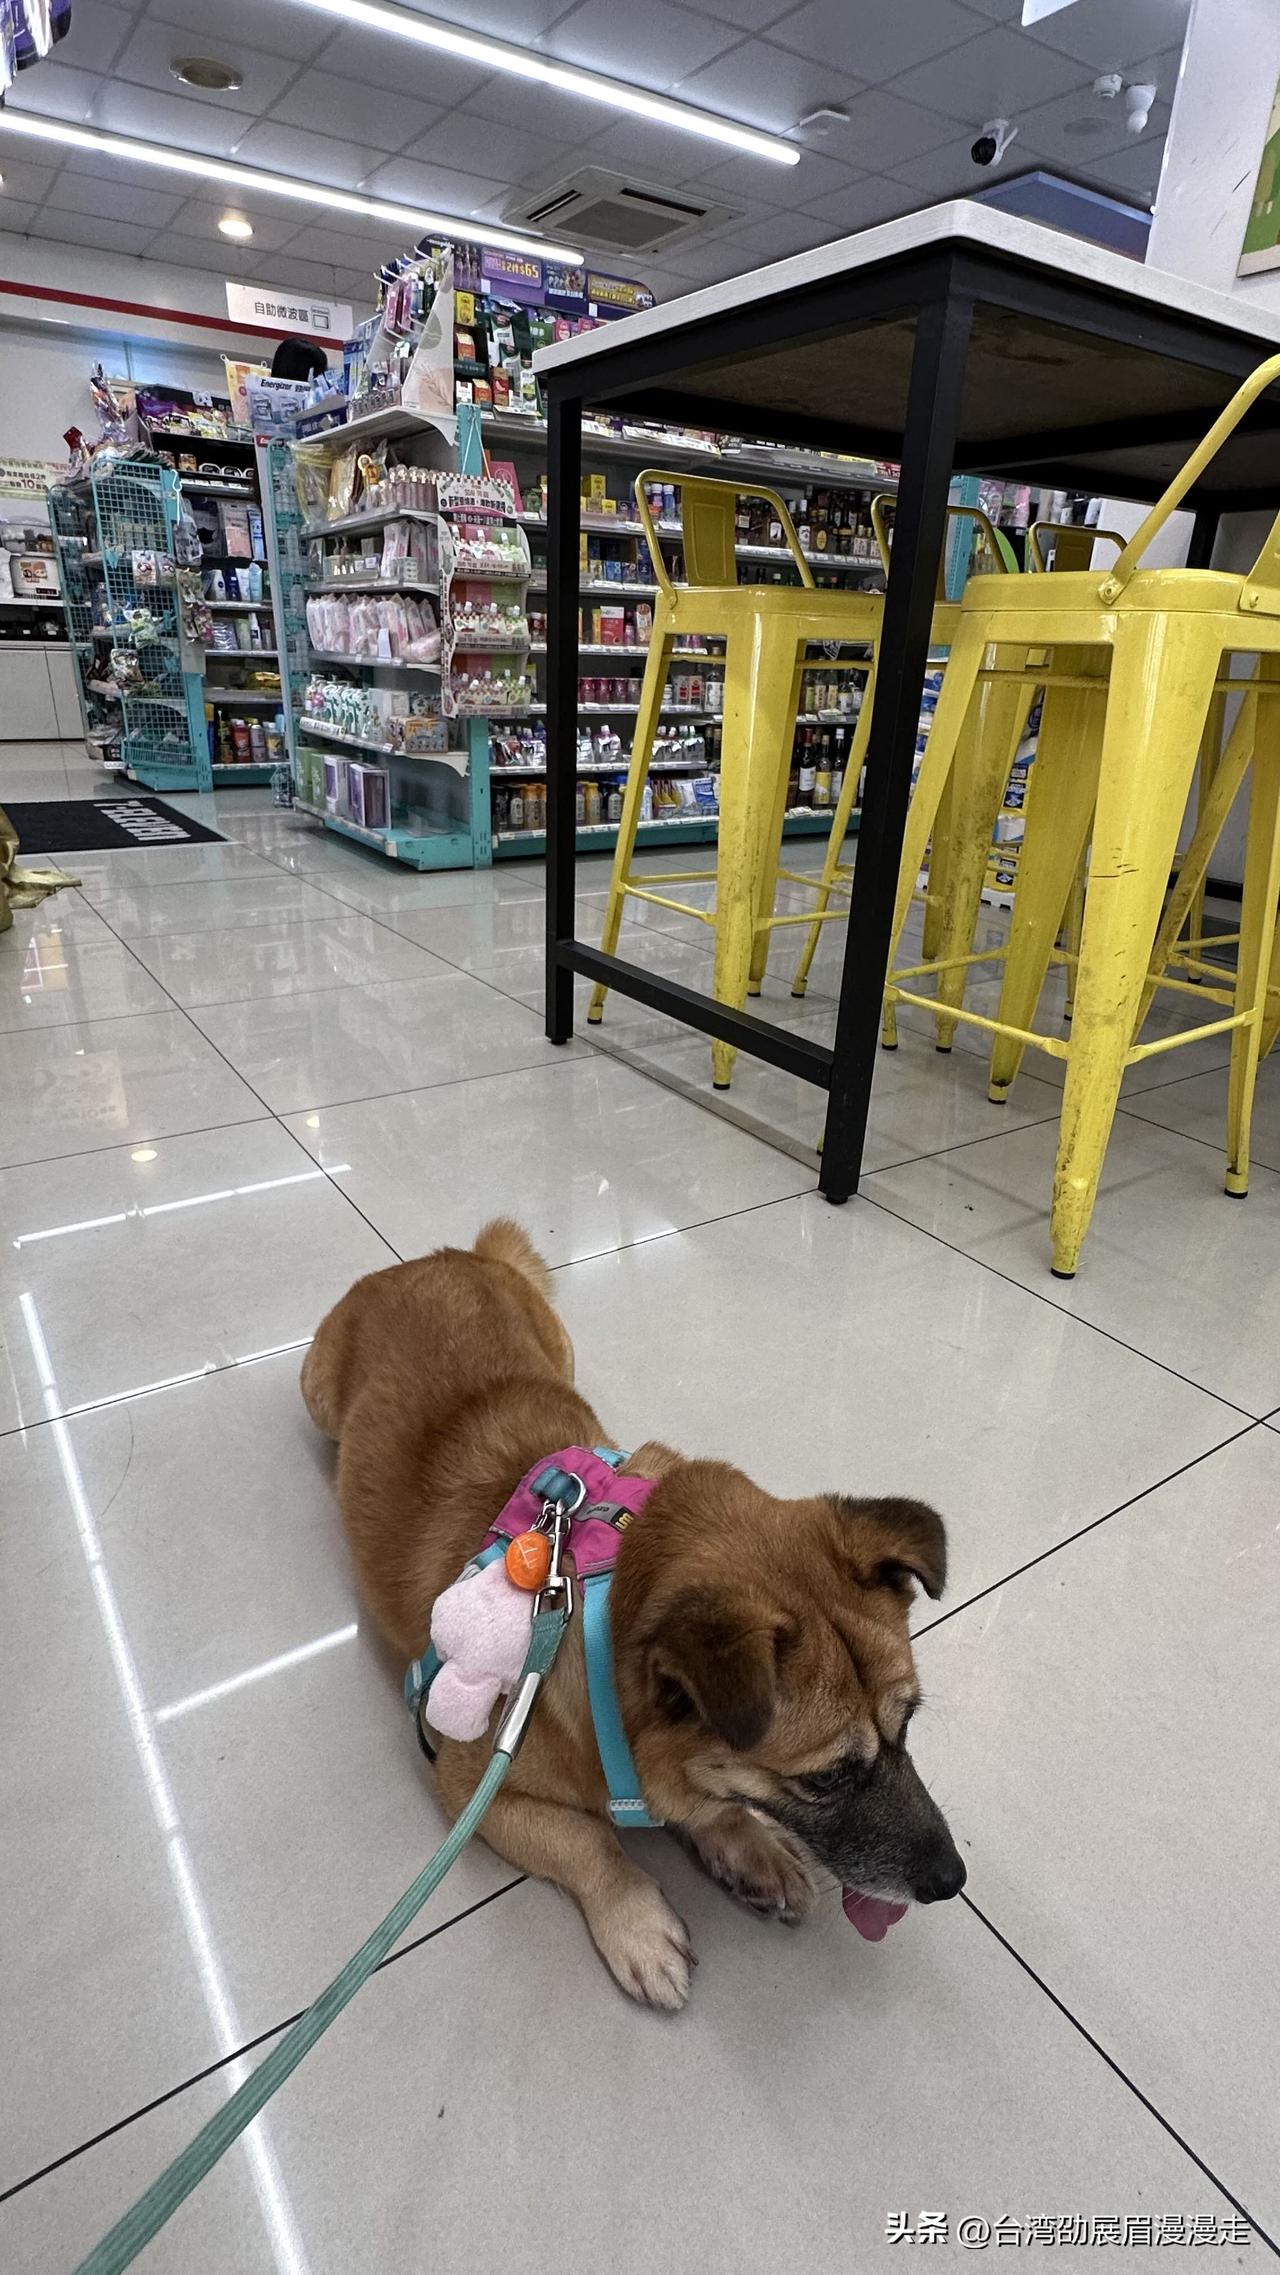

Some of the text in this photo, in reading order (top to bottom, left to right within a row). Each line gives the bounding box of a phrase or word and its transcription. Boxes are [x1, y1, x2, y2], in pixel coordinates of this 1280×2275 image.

[254, 302, 309, 322] 自助微波區
[260, 379, 292, 391] Energizer
